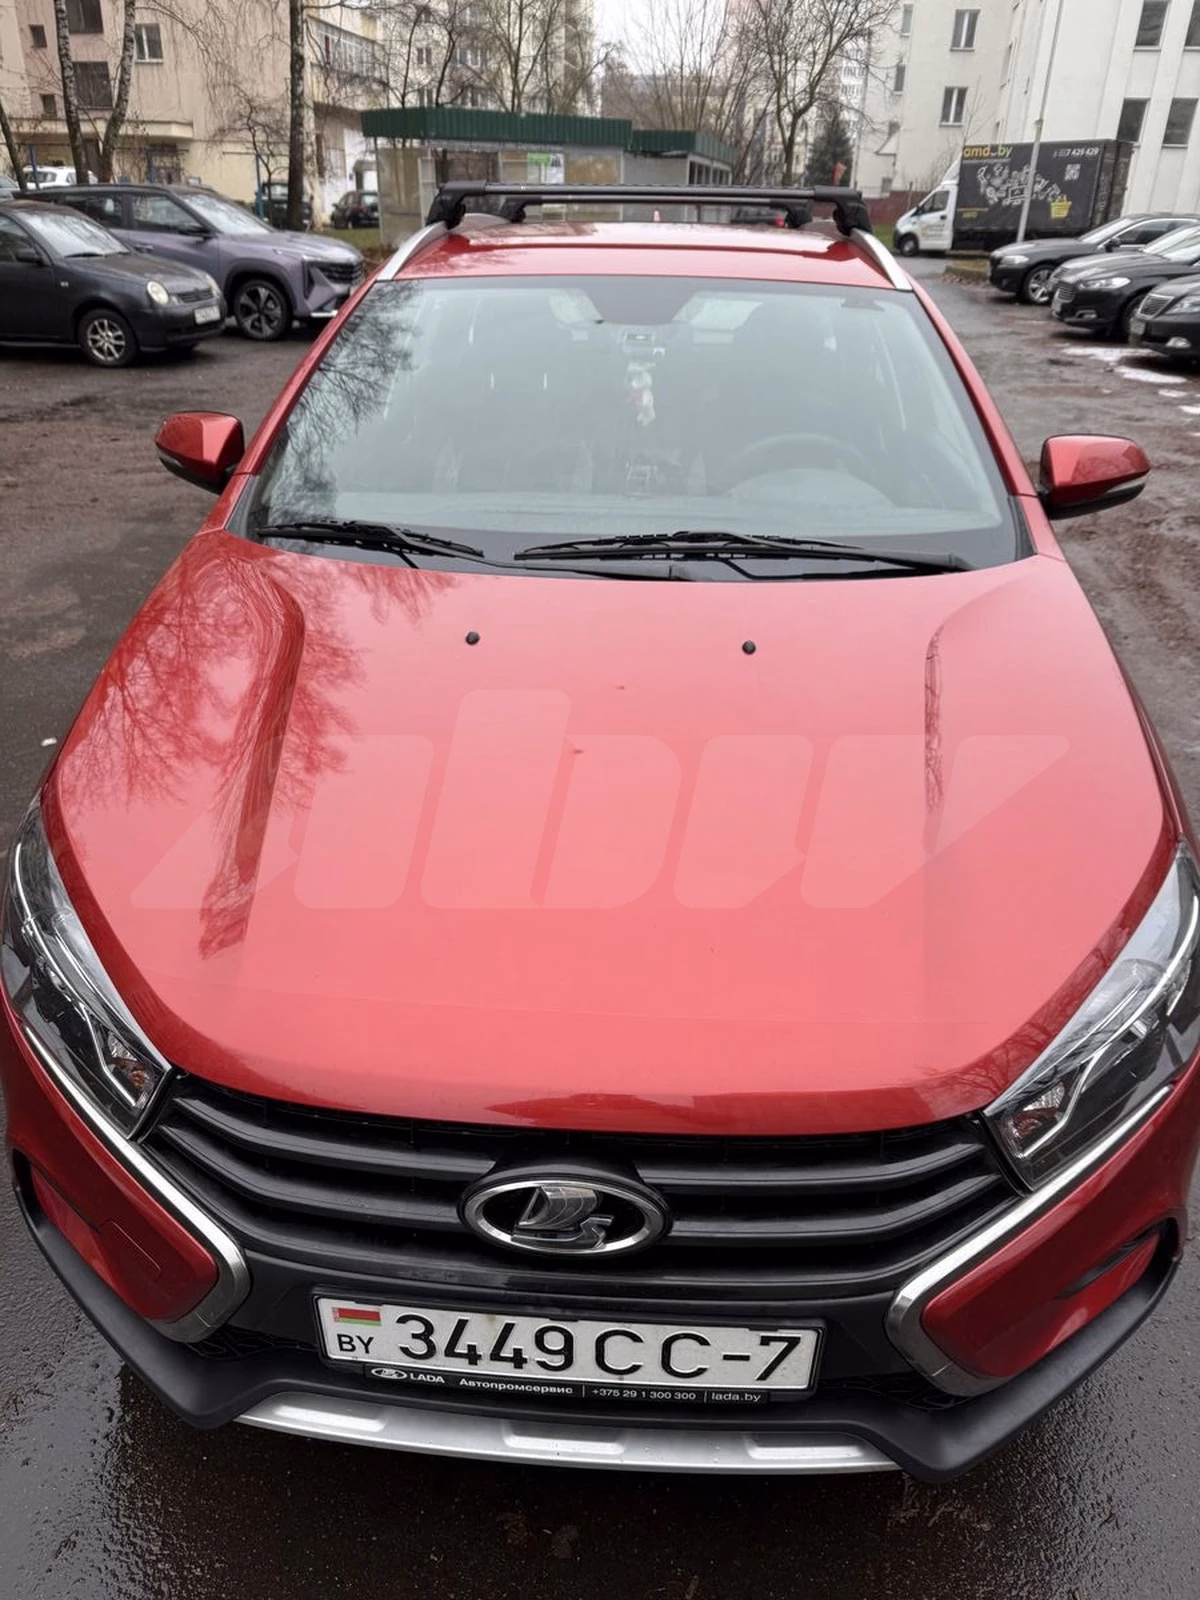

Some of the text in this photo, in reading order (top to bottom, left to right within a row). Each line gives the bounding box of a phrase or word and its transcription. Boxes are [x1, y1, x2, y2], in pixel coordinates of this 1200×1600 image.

[337, 1333, 374, 1354] BY
[395, 1313, 575, 1372] 3449
[410, 1373, 445, 1384] LADA
[459, 1378, 574, 1395] Автопромсервис
[592, 1388, 620, 1398] +375
[622, 1389, 637, 1398] 29
[650, 1391, 672, 1400] 300
[674, 1392, 696, 1401] 300
[711, 1392, 762, 1403] lada.by
